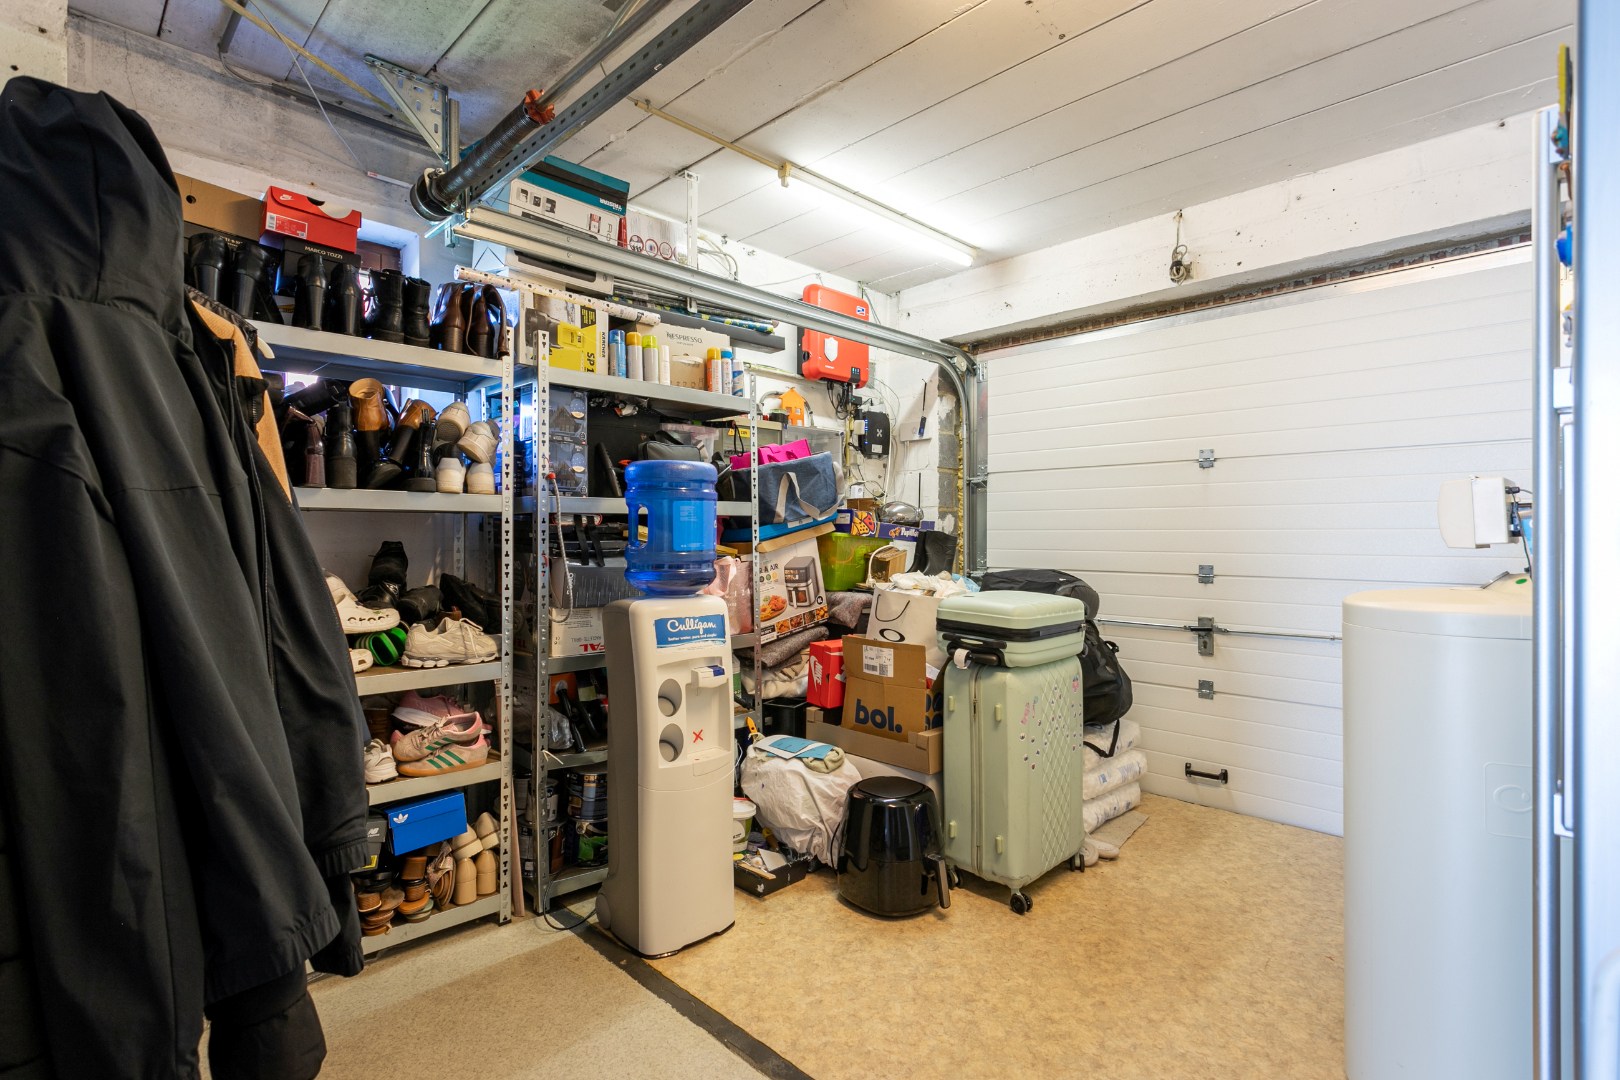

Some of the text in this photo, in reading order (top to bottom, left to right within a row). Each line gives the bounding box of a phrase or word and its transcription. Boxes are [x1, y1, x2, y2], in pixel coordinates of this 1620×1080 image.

[305, 245, 326, 255] MARCO
[586, 352, 595, 366] SP
[667, 618, 716, 634] Culligan
[855, 698, 903, 733] bol.
